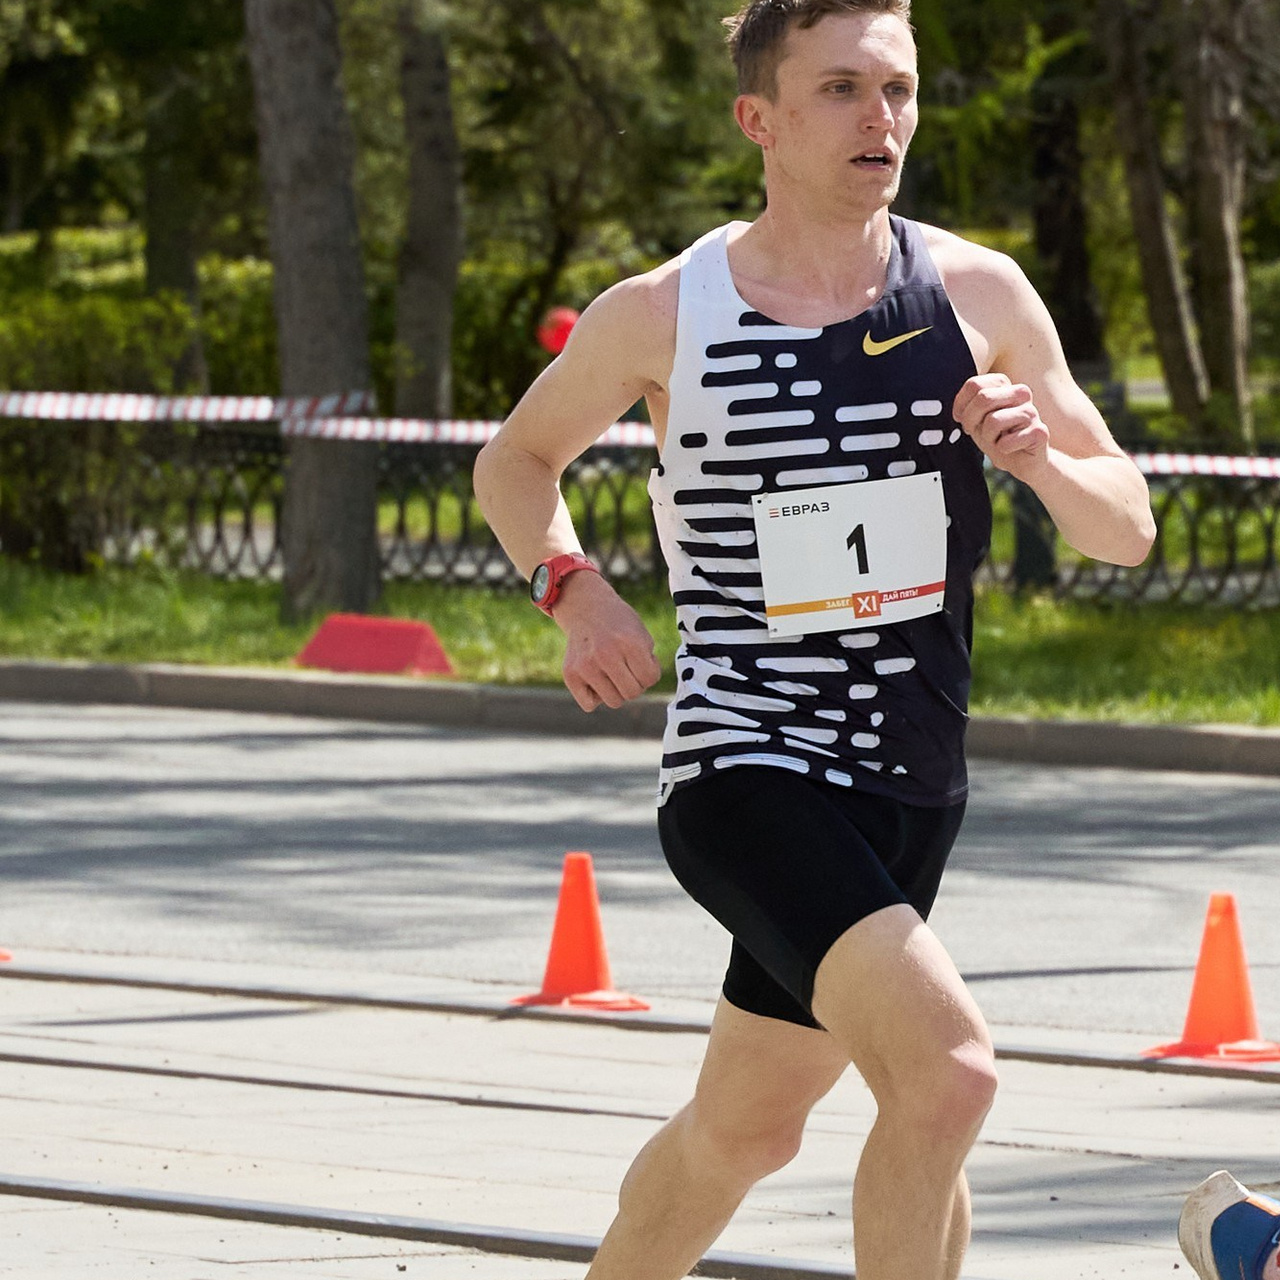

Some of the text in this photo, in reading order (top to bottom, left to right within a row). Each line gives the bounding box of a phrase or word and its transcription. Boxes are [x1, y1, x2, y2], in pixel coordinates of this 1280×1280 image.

[781, 501, 830, 517] ЕВРАЗ
[846, 523, 870, 575] 1
[825, 599, 850, 609] ЗАБЕГ
[857, 595, 878, 613] XI
[882, 591, 899, 602] ДАЙ
